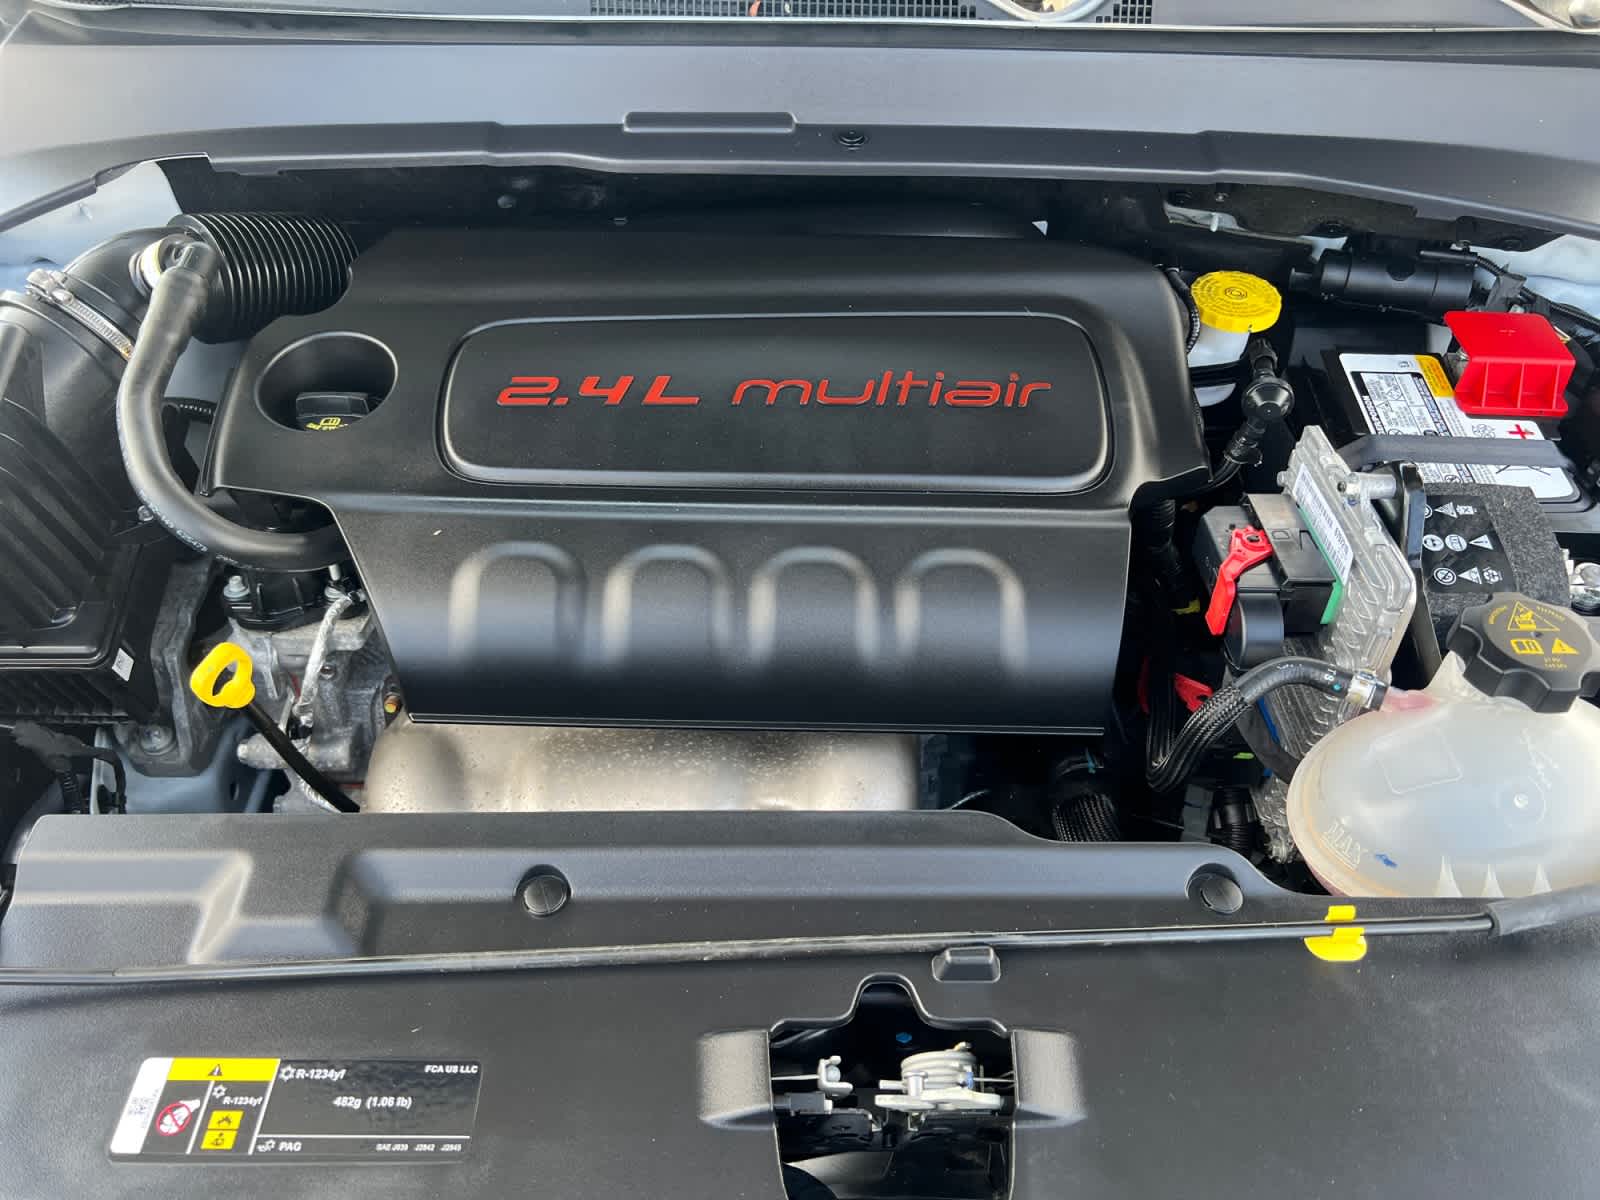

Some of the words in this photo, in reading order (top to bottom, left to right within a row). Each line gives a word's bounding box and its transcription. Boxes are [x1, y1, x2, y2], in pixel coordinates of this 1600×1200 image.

[496, 375, 699, 406] 2.4L
[731, 370, 1053, 407] multiair
[295, 1067, 346, 1081] R-1234yf
[425, 1065, 445, 1073] FCA
[446, 1065, 459, 1073] US
[460, 1065, 479, 1073] LLC
[222, 1096, 263, 1107] R-1234yf
[333, 1096, 361, 1108] 482g
[278, 1141, 302, 1152] PAG
